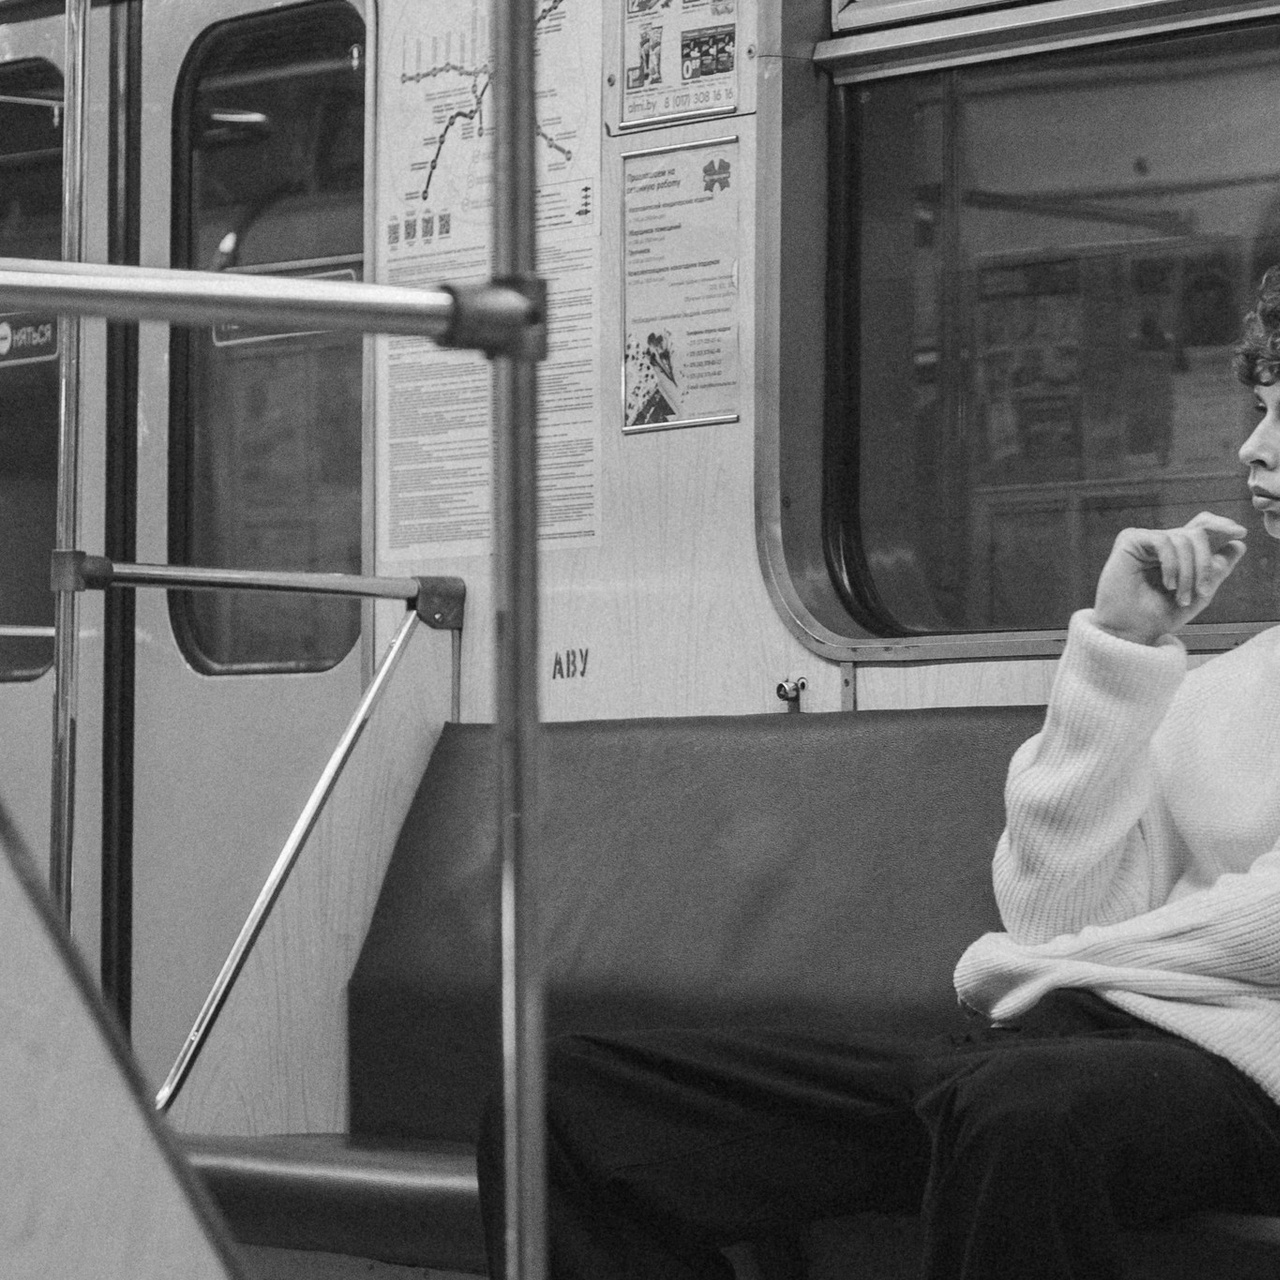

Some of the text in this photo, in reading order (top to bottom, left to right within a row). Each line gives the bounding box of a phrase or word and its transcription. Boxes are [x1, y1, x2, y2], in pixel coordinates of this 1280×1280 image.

[693, 90, 710, 104] 308
[712, 89, 722, 102] 16
[724, 87, 734, 100] 16
